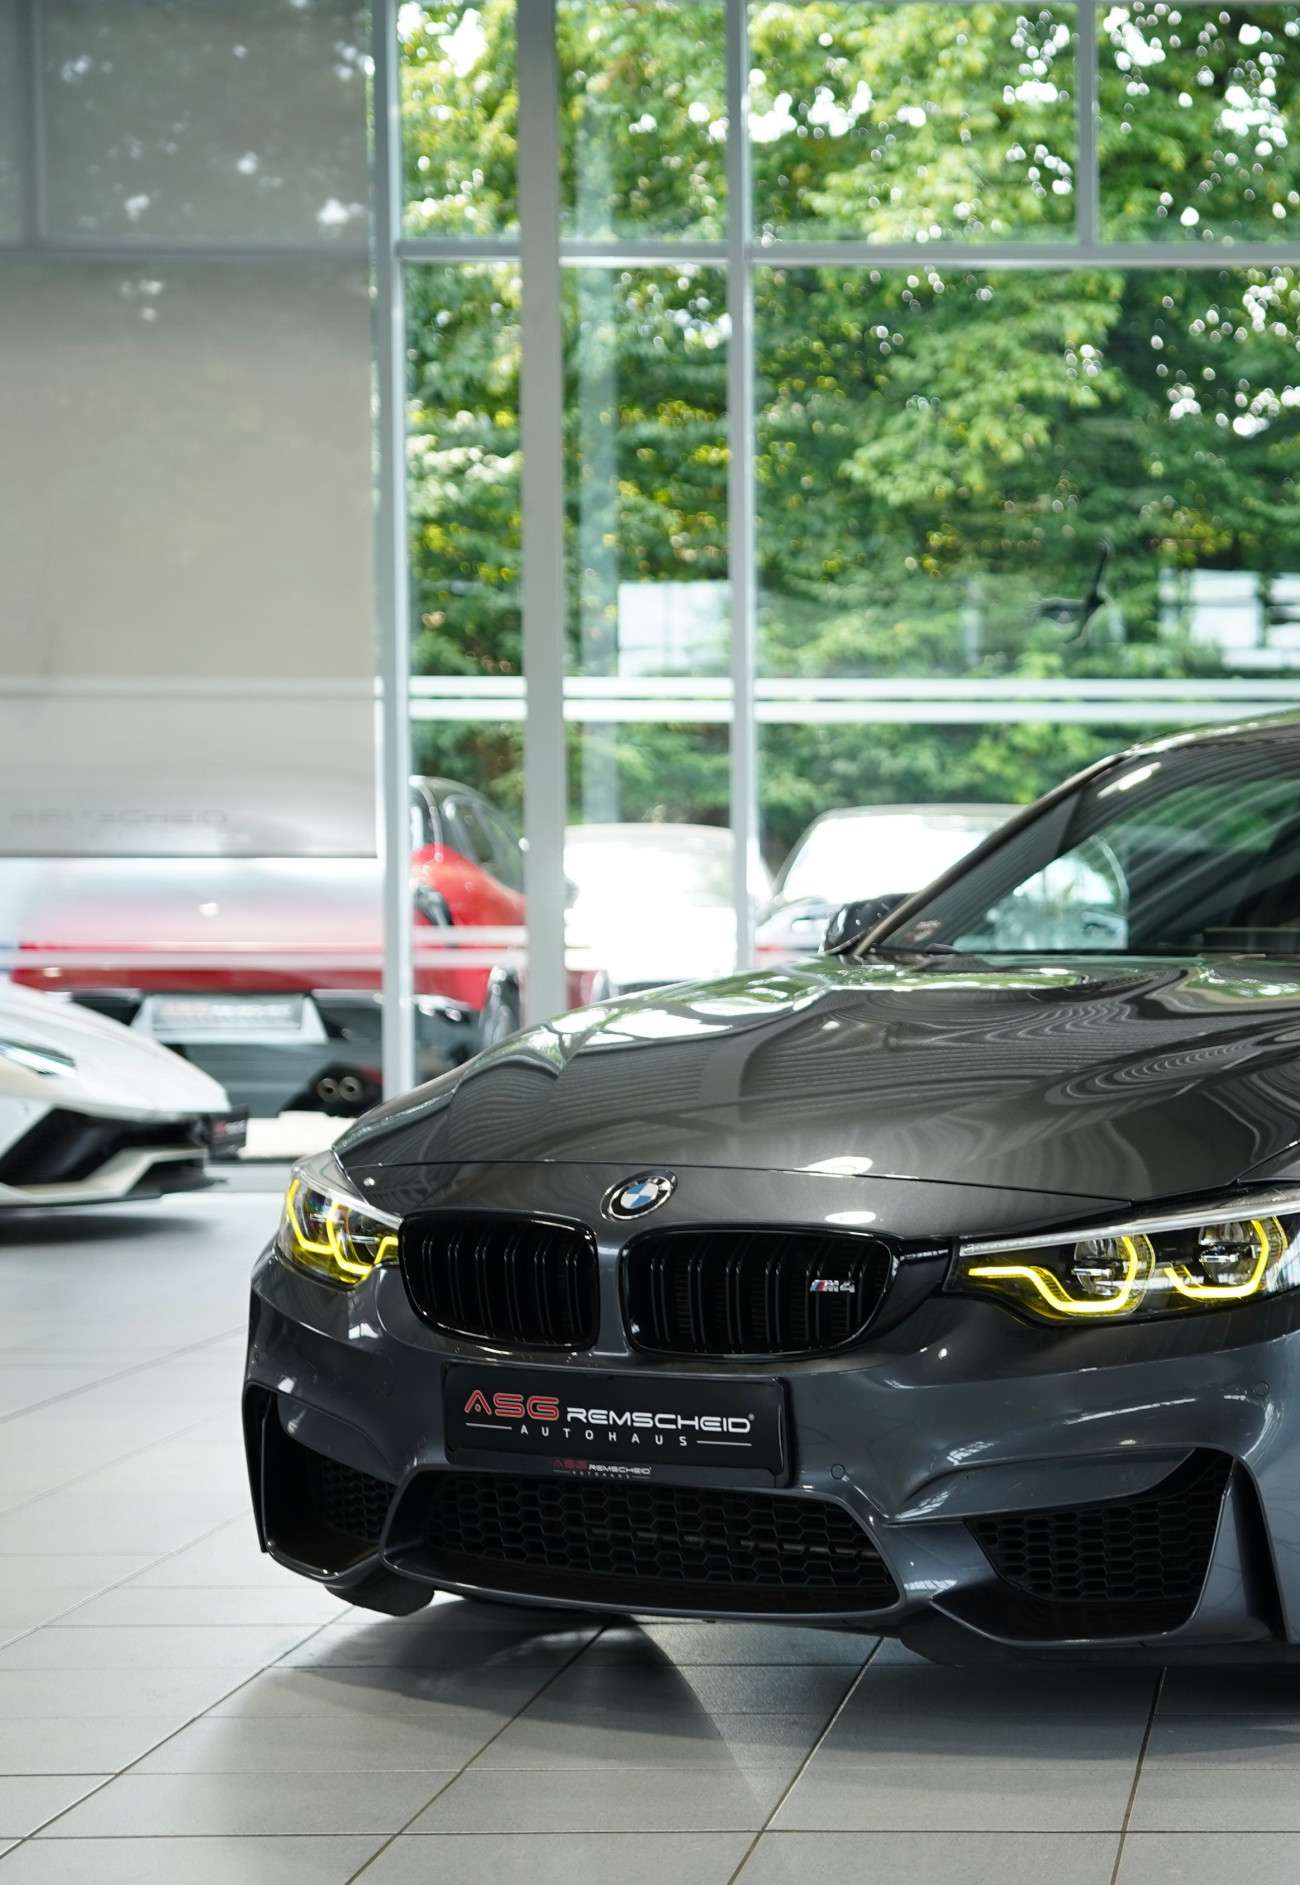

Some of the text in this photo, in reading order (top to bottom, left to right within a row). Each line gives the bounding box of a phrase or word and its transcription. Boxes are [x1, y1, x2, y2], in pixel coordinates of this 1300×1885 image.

[464, 1390, 751, 1434] ASG REMSCHEID
[520, 1424, 688, 1447] AUTOHAUS
